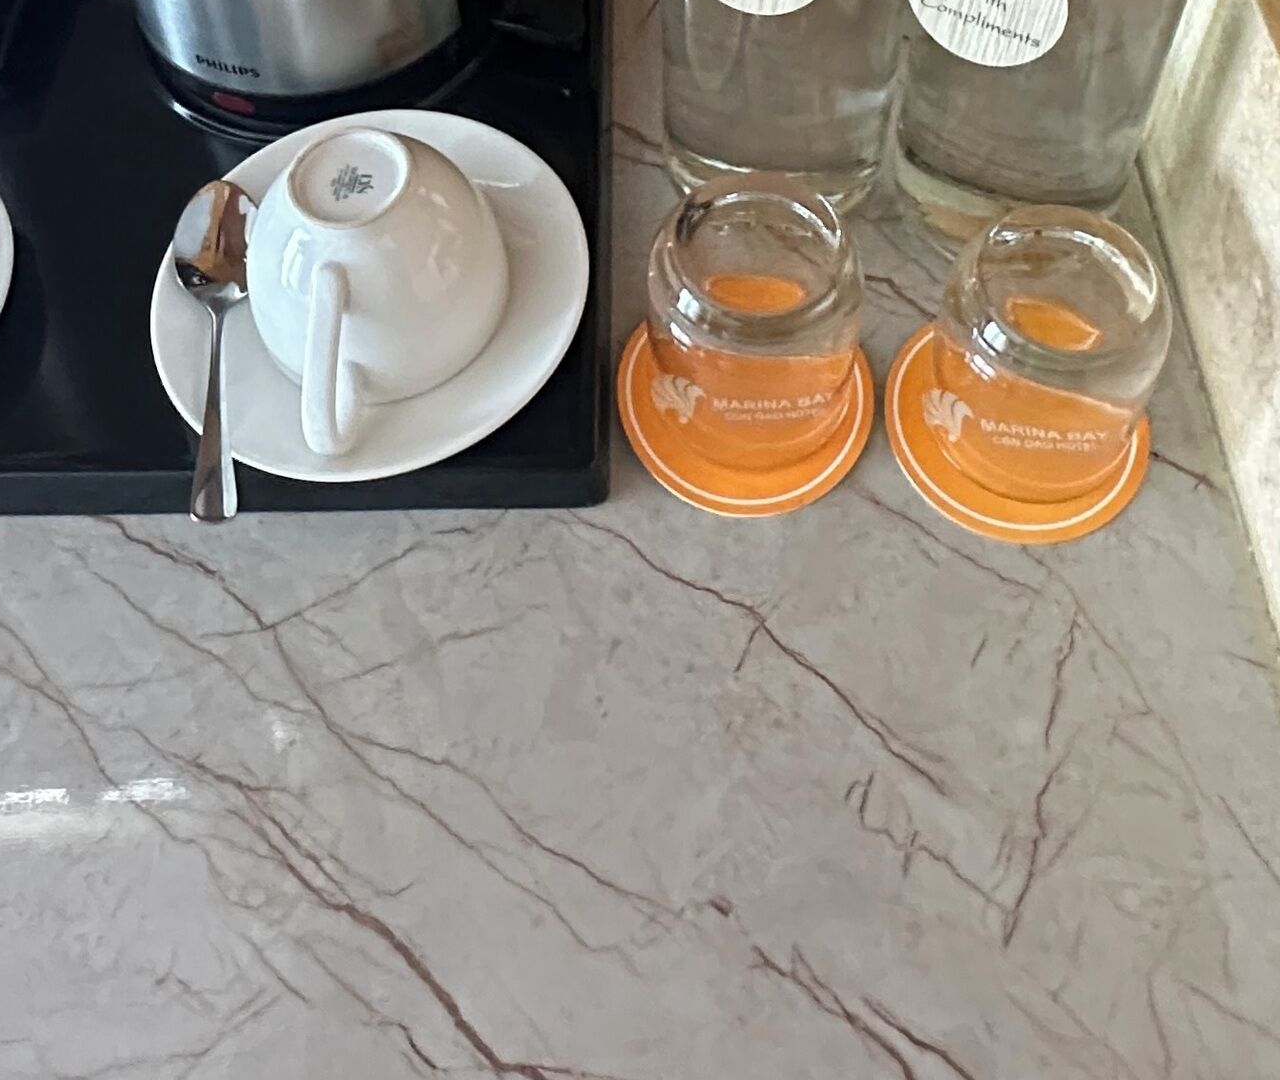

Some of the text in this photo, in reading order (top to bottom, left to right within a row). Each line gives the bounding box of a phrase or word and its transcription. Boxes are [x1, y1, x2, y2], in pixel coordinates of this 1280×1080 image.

[195, 54, 261, 78] PHILIPS
[713, 392, 833, 410] MARINA BAY
[980, 418, 1108, 441] MARINA BAY
